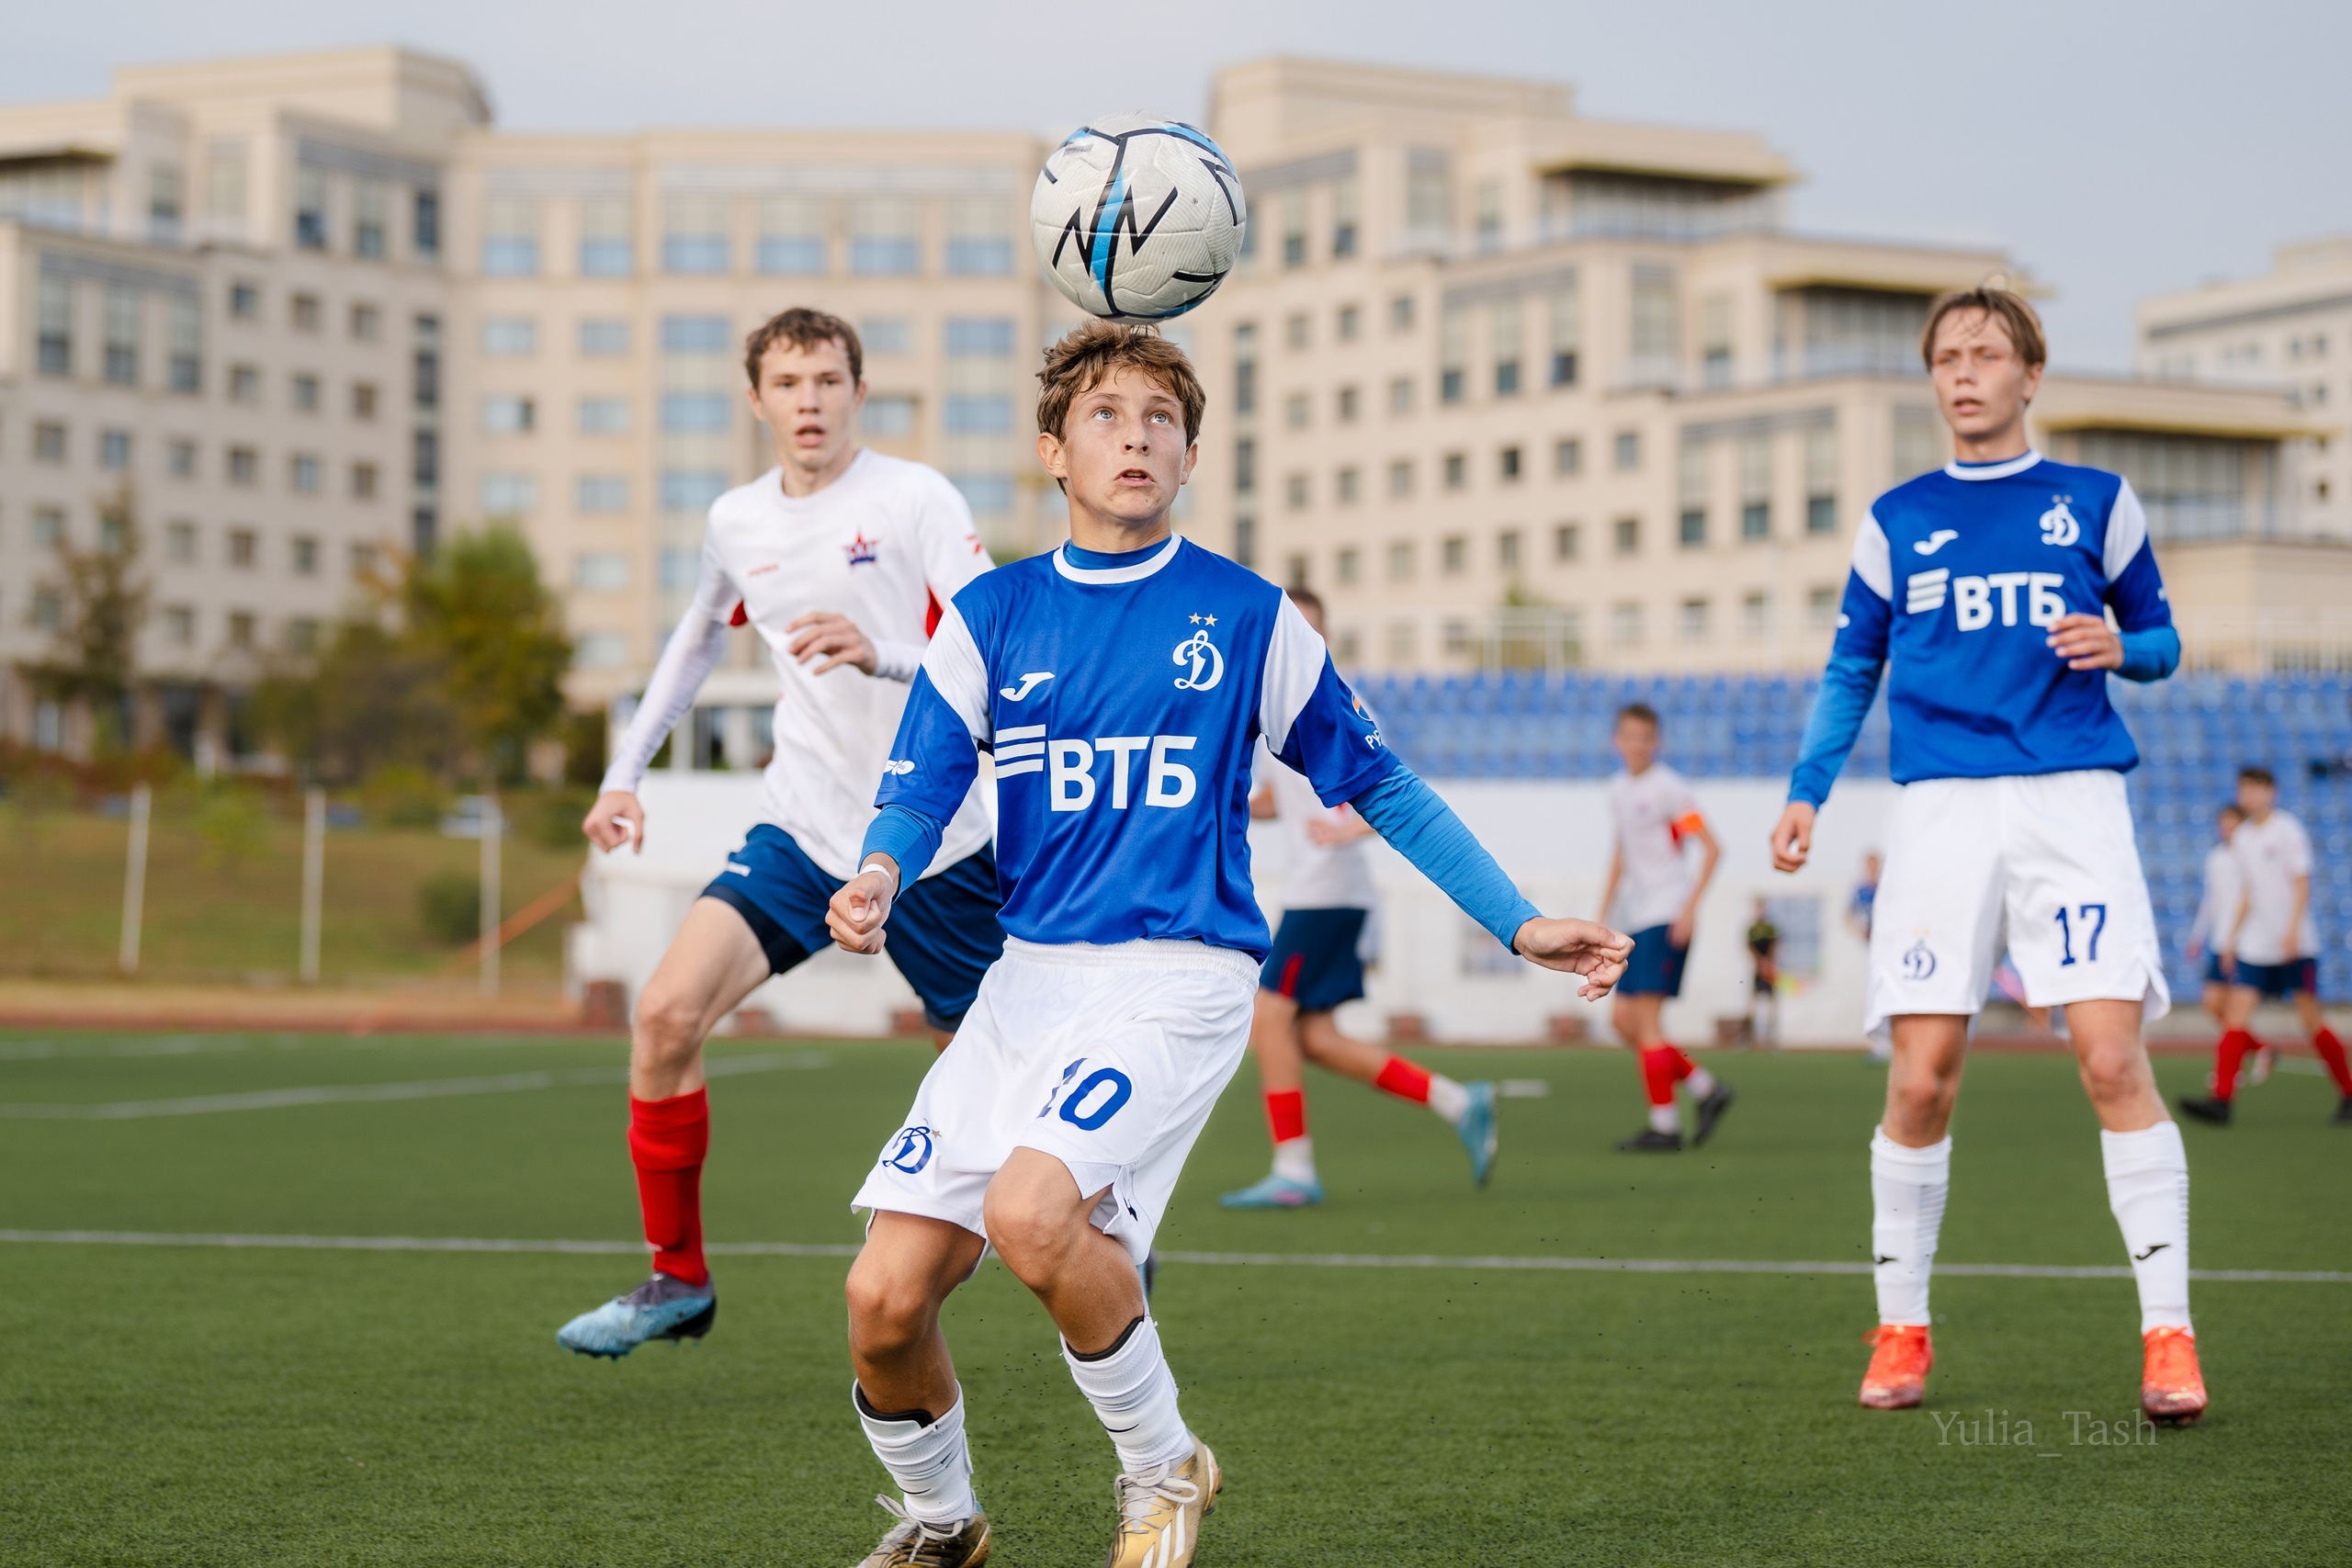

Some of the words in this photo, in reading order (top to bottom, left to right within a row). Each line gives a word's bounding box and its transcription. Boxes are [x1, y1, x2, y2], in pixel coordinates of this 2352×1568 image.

[1953, 571, 2066, 632] ВТБ
[1048, 735, 1198, 812] ВТБ
[2054, 904, 2107, 966] 17
